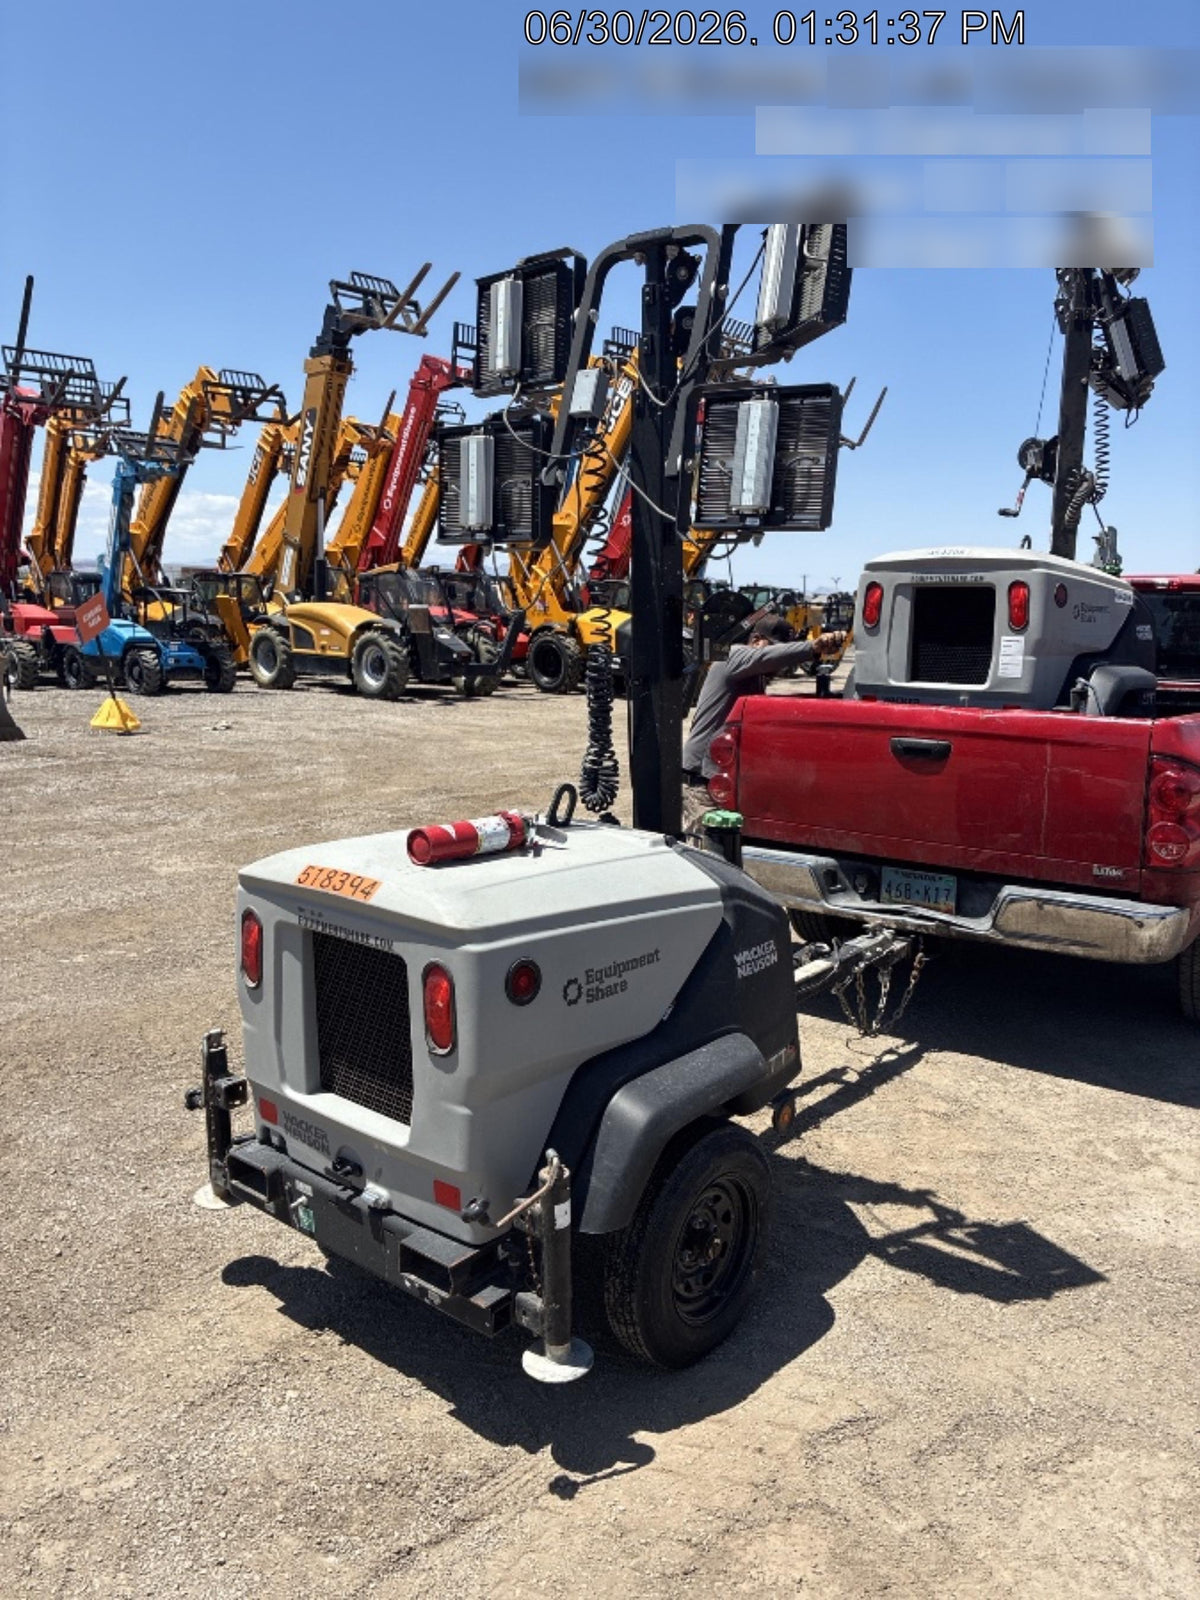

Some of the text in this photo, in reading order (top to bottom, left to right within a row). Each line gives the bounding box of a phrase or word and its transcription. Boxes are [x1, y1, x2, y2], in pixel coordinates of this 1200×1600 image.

[606, 378, 633, 433] JCB
[296, 418, 314, 486] SANY
[298, 865, 378, 900] 518394
[584, 947, 661, 986] Equipment
[733, 940, 776, 966] WACKER
[737, 951, 778, 979] NEUSON
[585, 979, 629, 1004] Share
[282, 1110, 329, 1143] WACKER
